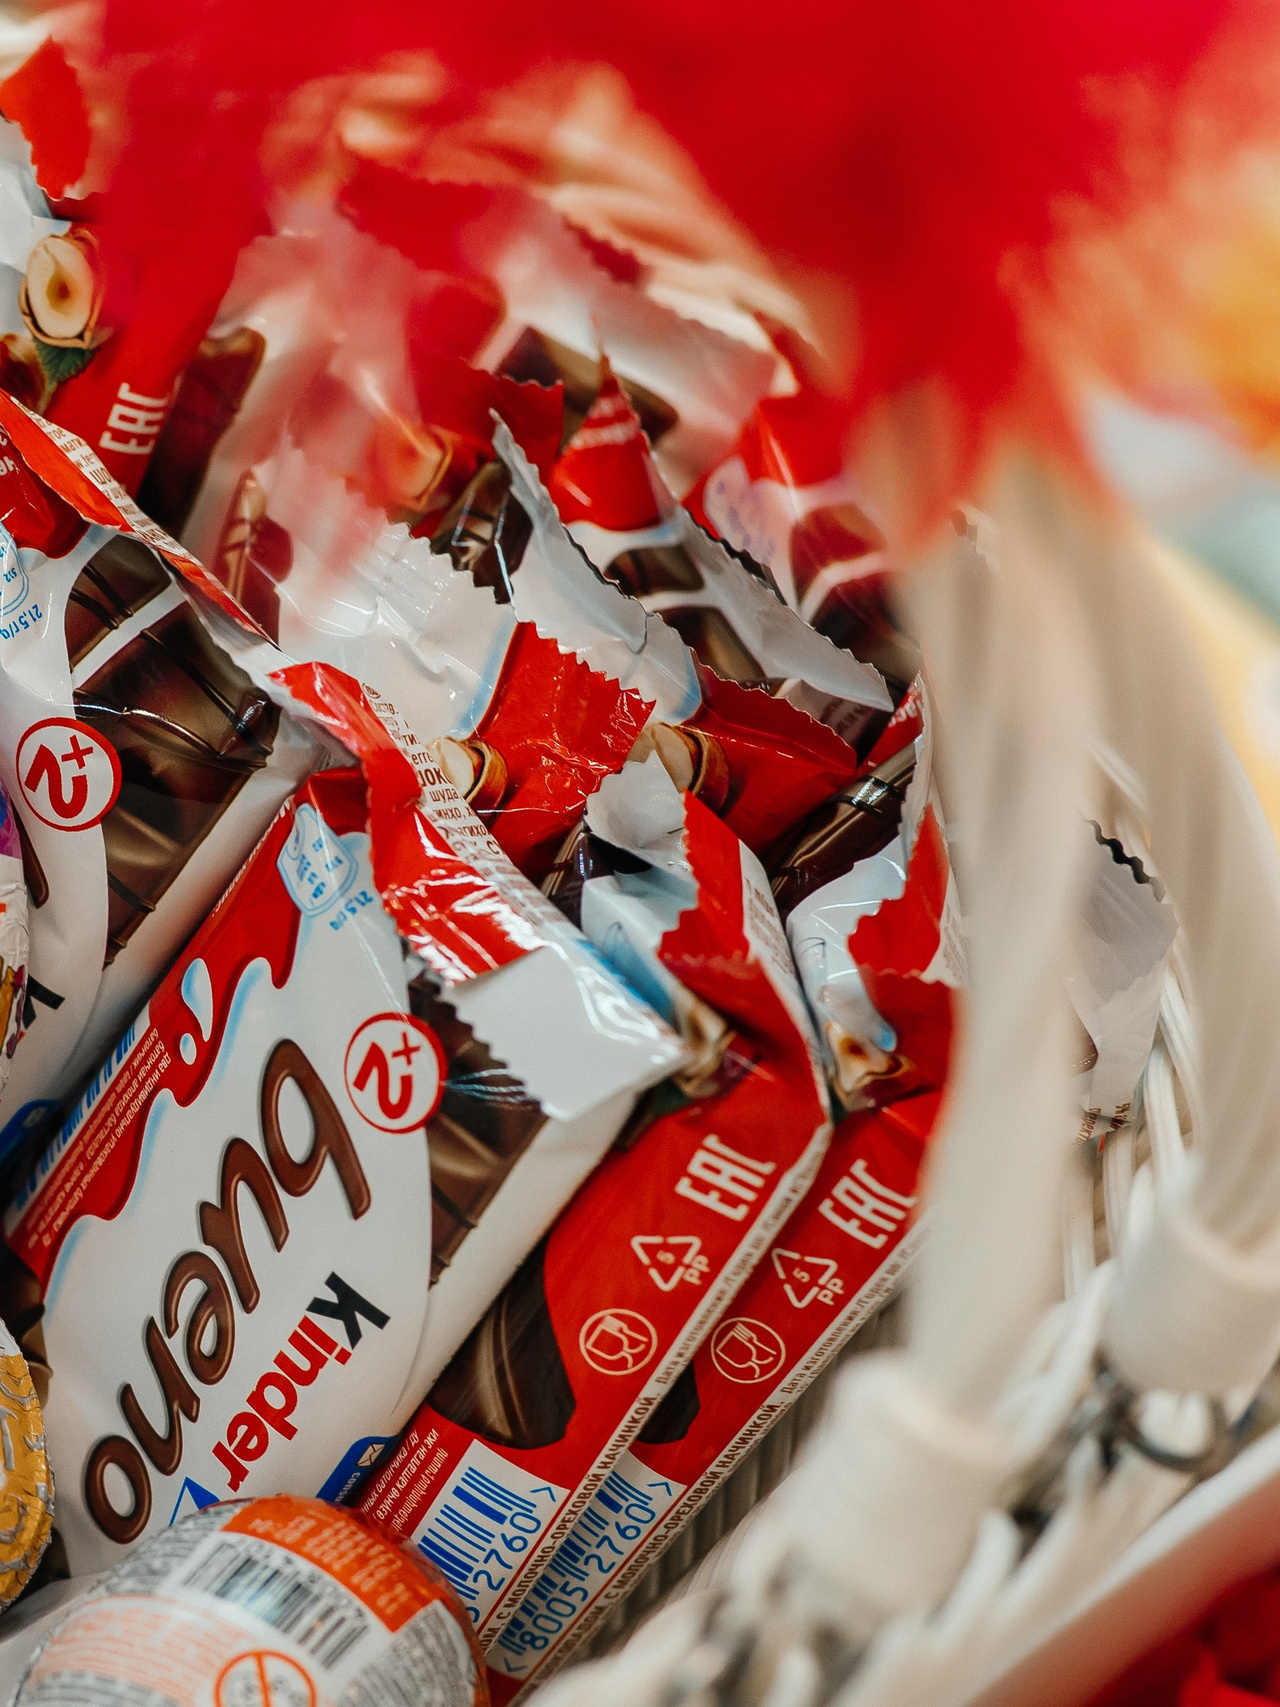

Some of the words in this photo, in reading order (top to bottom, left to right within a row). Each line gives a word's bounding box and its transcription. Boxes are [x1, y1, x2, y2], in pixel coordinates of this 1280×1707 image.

[15, 602, 44, 630] 21,5
[83, 1038, 373, 1545] bueno
[371, 1445, 409, 1494] батончика
[393, 1444, 430, 1491] капталган
[612, 1464, 722, 1592] МОЛОЧНО-ОРЕХОВОЙ
[501, 1466, 605, 1615] МОЛОЧНО-ОРЕХОВОЙ
[521, 1585, 590, 1651] 8005
[583, 1502, 657, 1577] 2760
